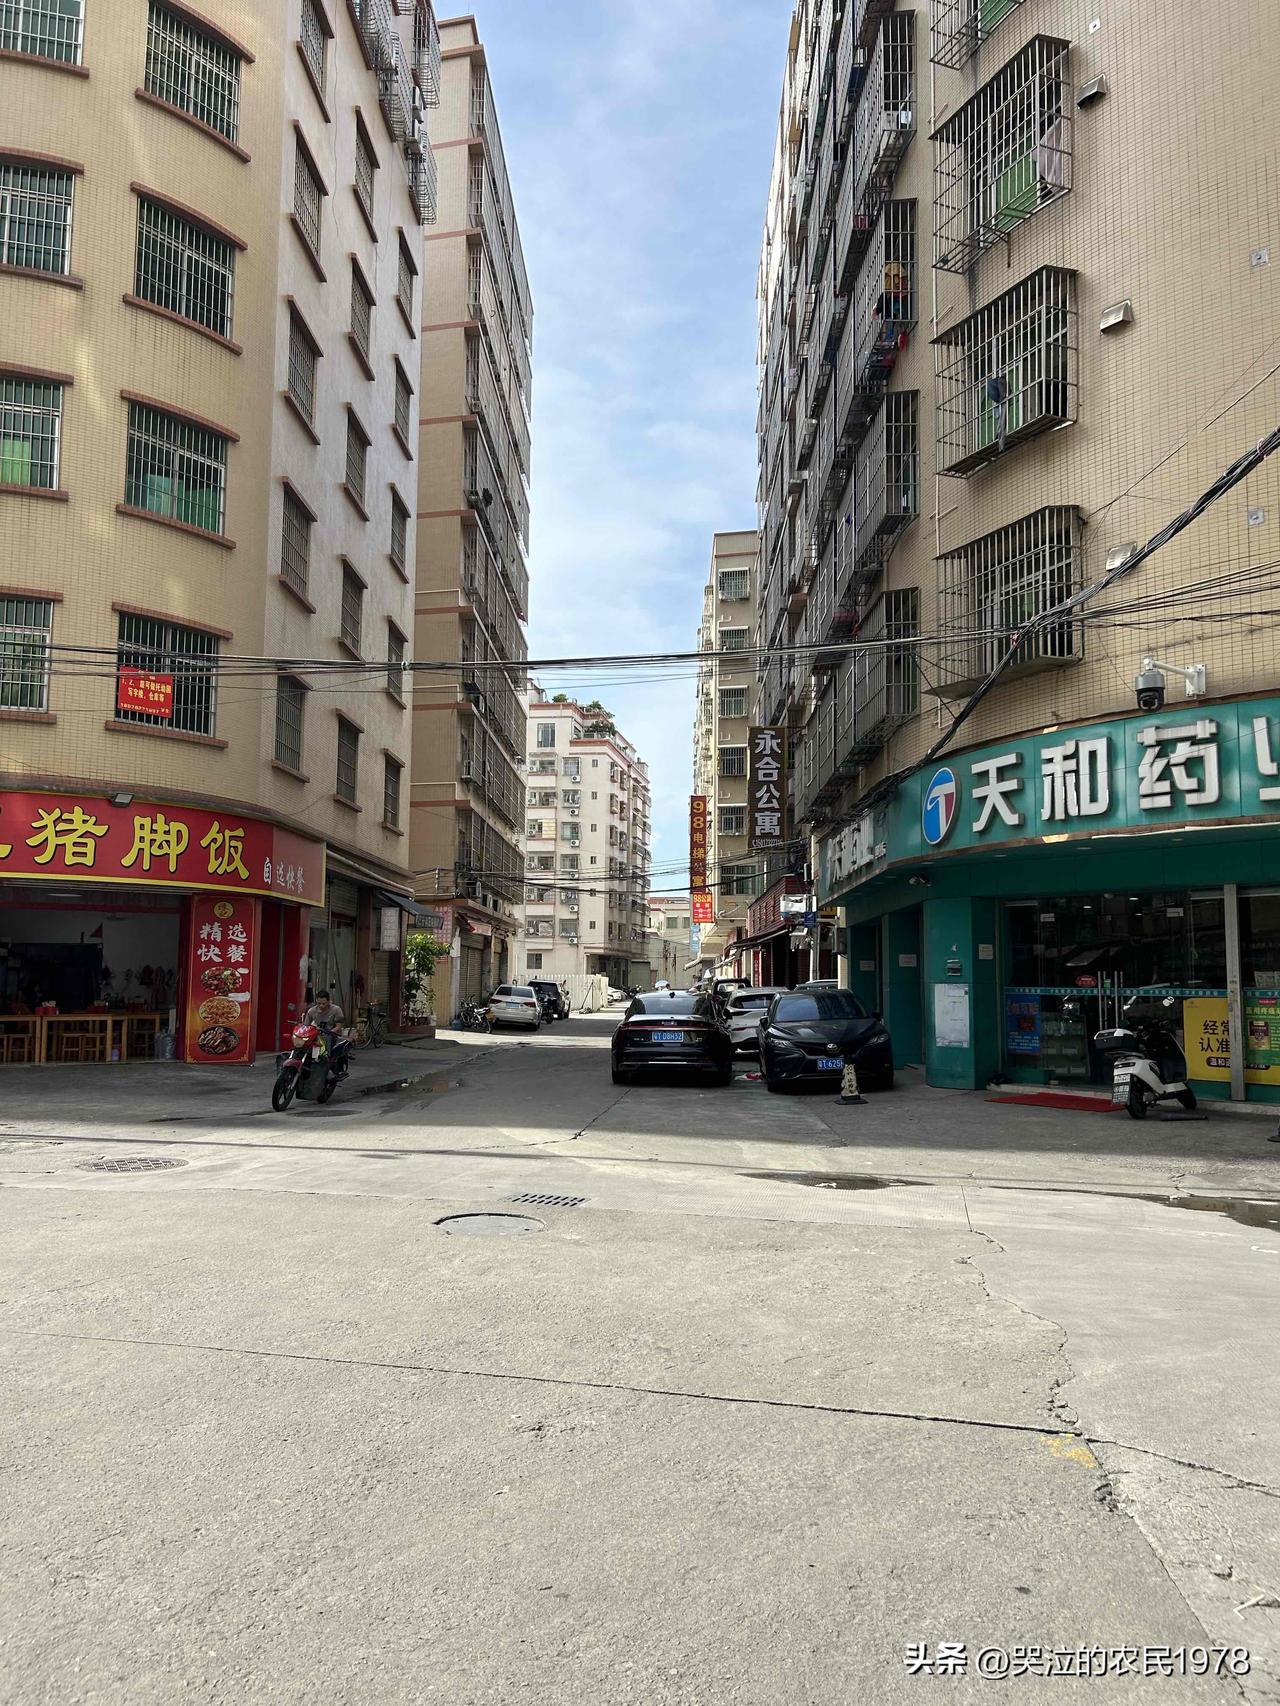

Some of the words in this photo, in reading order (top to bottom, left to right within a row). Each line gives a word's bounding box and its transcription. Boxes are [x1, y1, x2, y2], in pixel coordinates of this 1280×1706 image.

[754, 729, 782, 837] 永合公寓
[0, 805, 250, 881] 猪脚饭
[692, 800, 705, 887] 98电梯公寓
[1199, 1037, 1231, 1053] 认准
